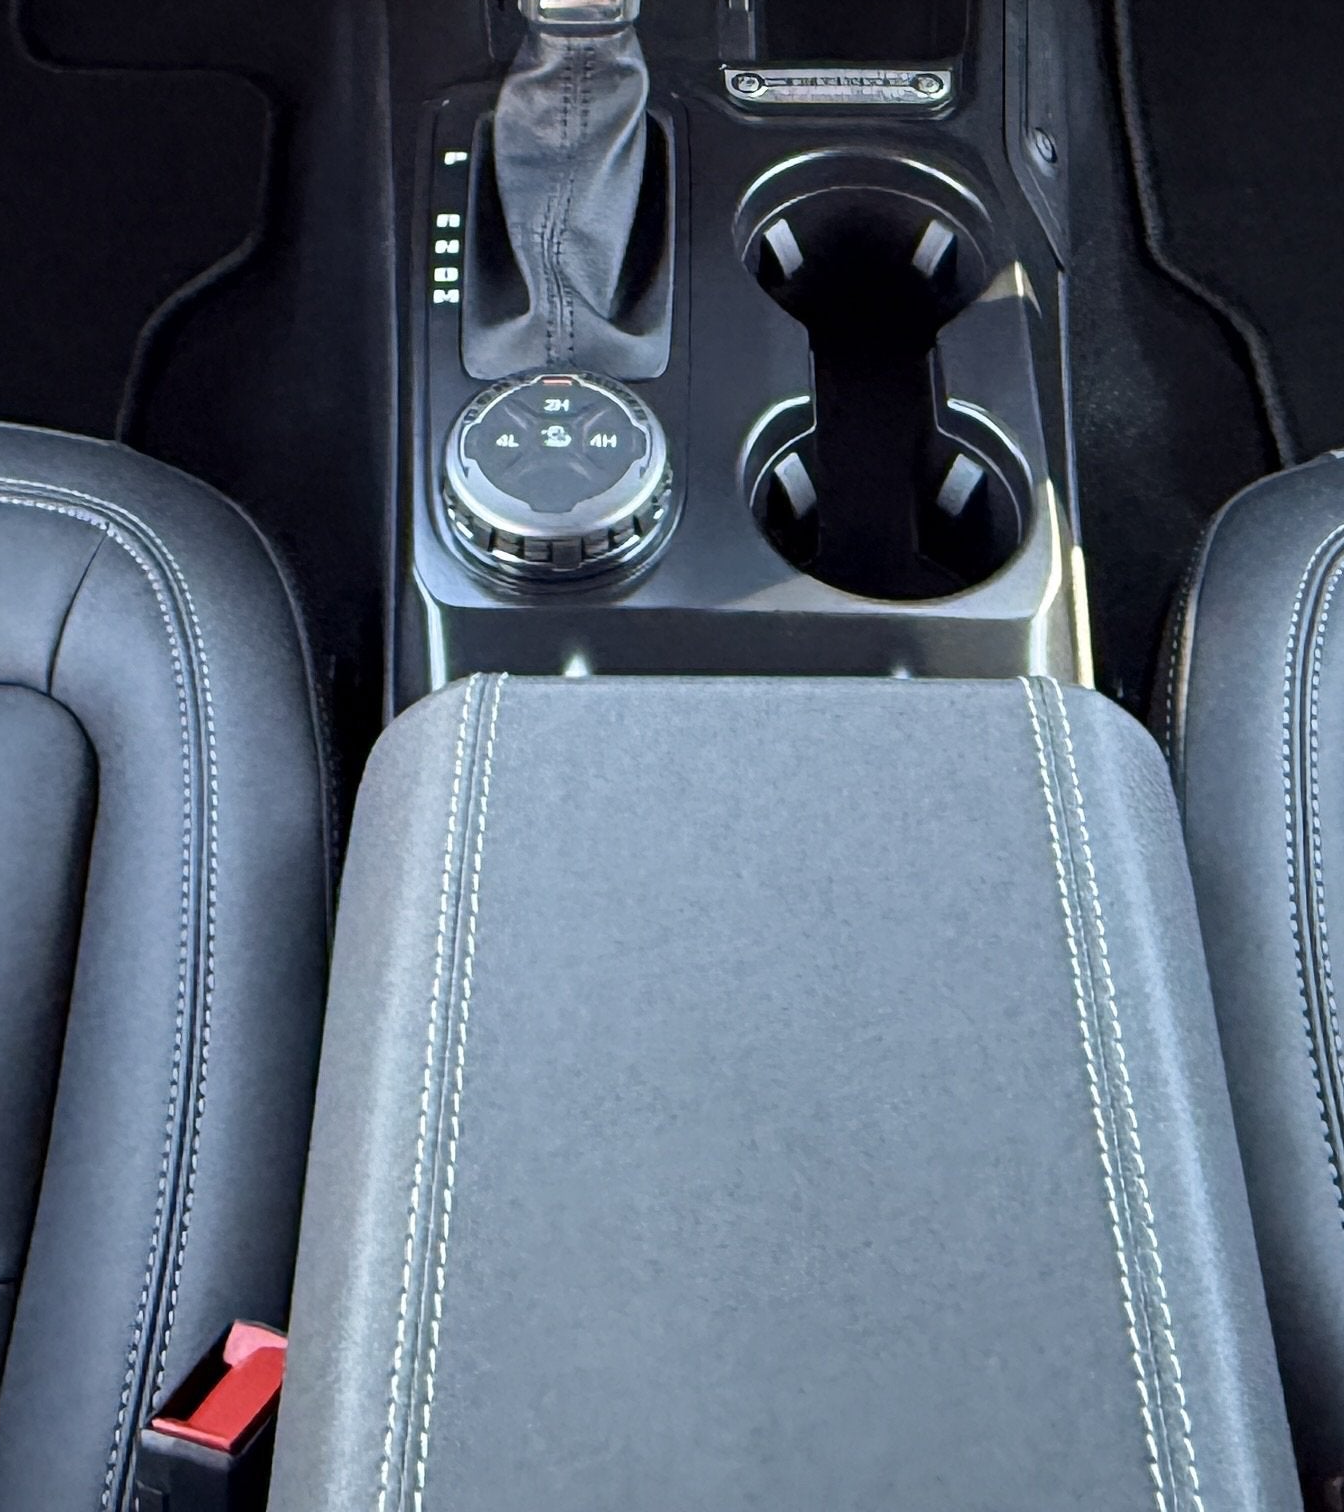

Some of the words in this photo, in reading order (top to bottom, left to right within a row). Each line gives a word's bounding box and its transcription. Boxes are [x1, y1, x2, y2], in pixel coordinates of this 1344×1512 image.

[544, 399, 569, 412] 2H
[496, 434, 519, 447] 4L
[589, 434, 617, 447] 4H
